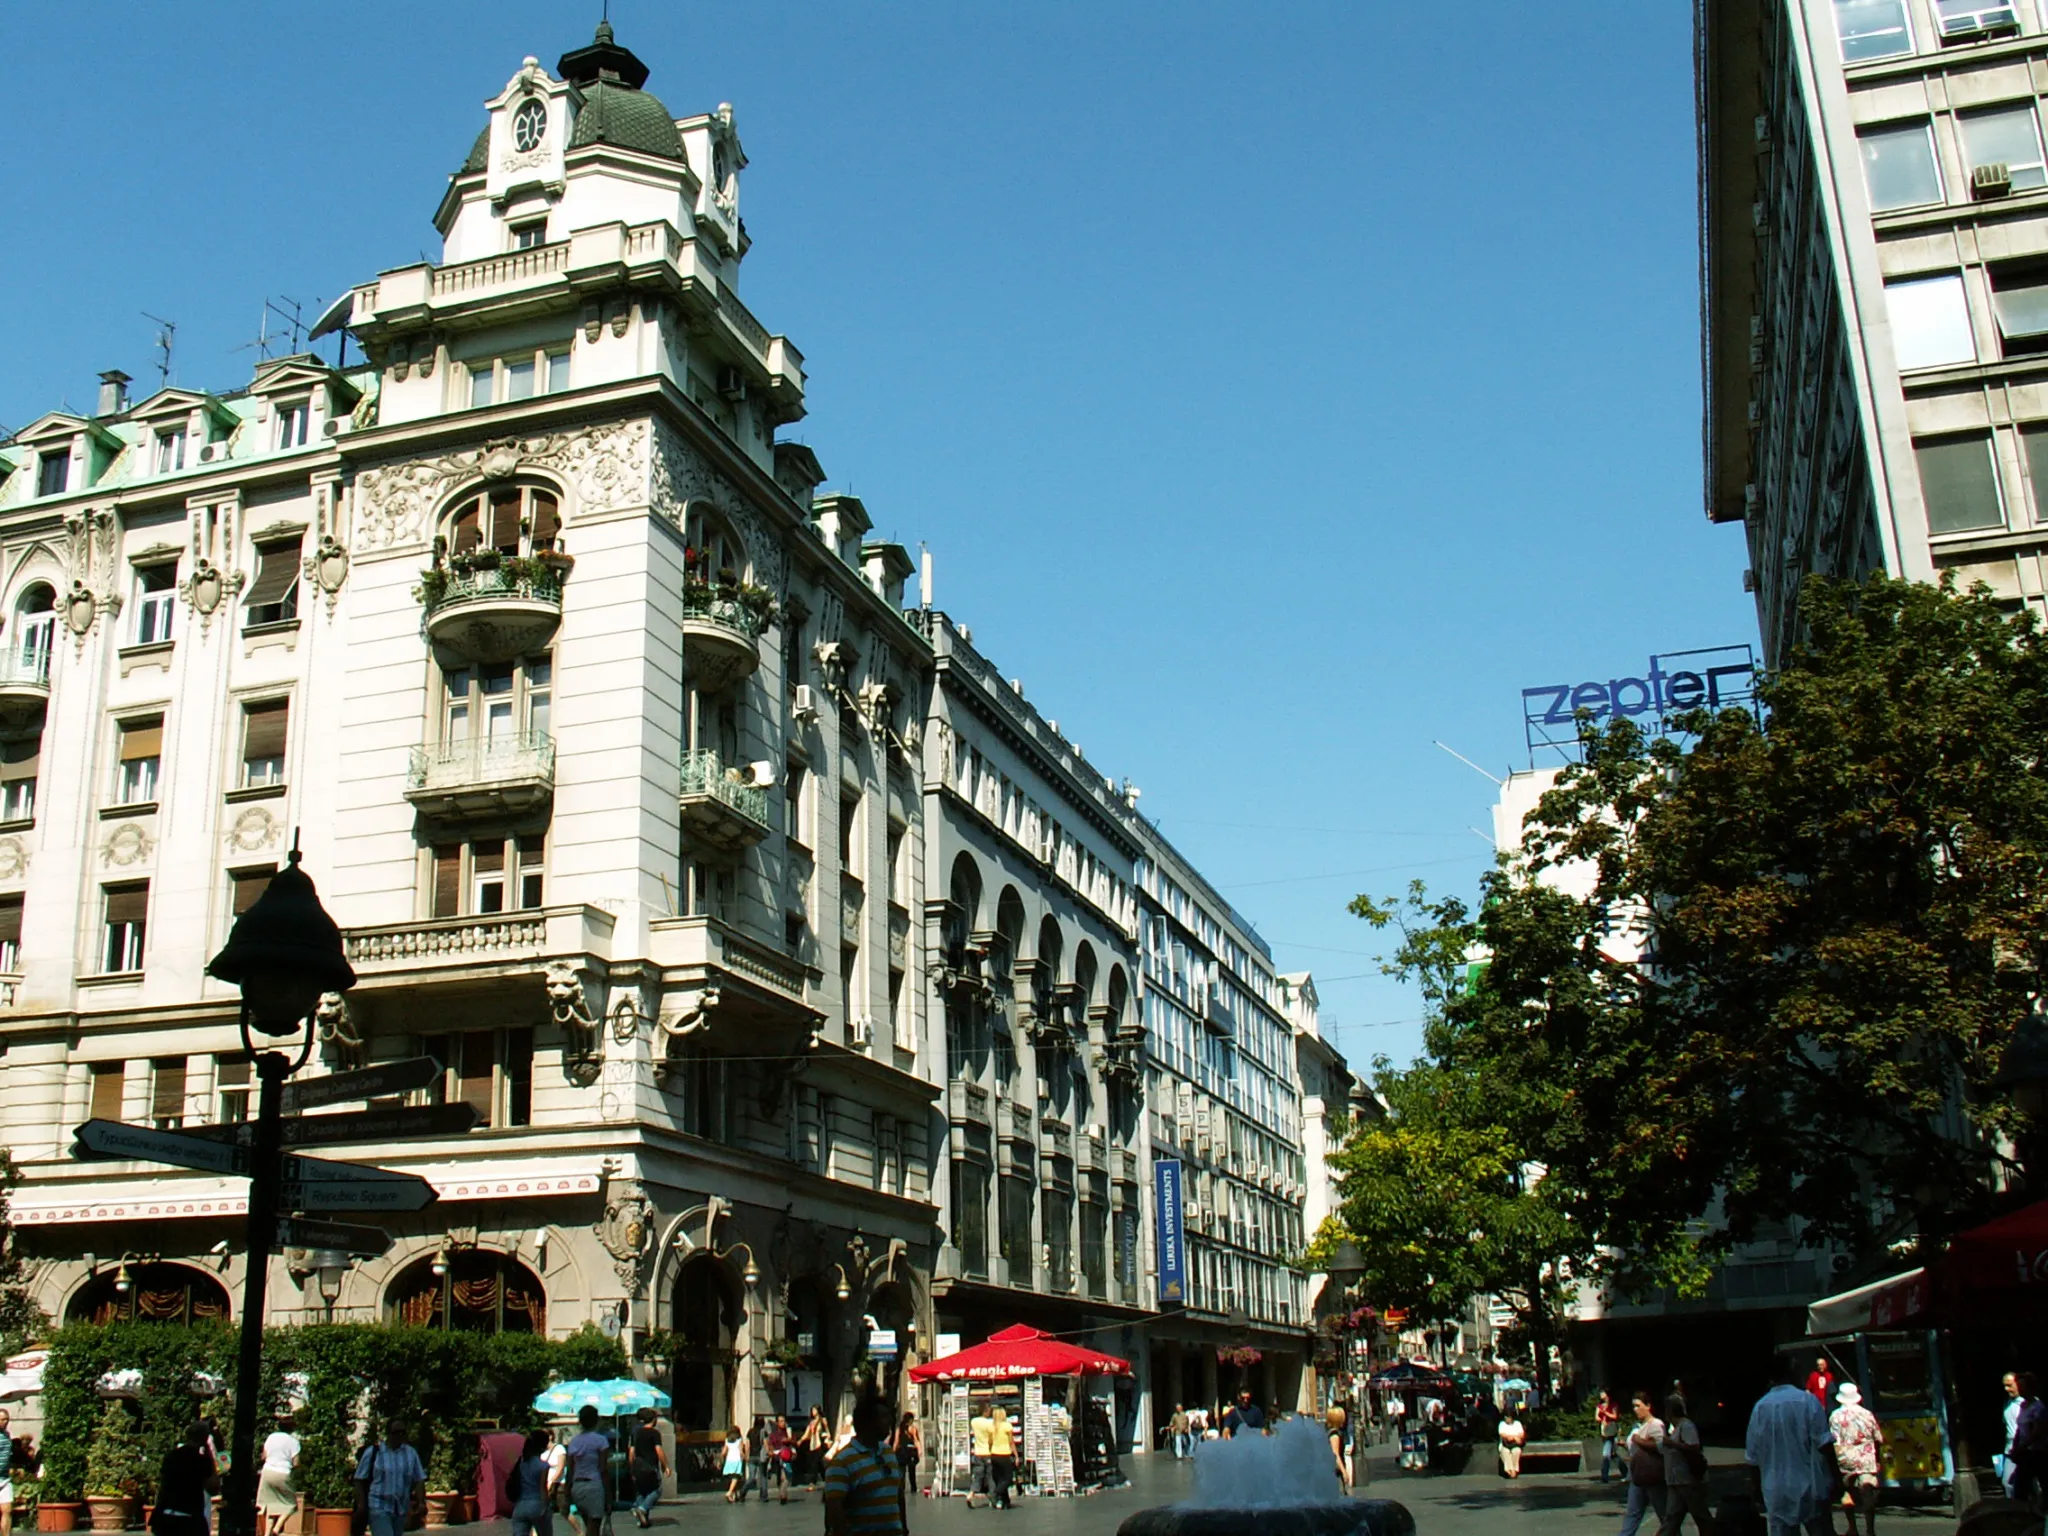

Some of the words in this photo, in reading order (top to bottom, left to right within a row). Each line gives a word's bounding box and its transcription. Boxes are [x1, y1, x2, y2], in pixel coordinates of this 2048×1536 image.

[1522, 655, 1753, 725] zepter
[1162, 1169, 1175, 1234] INVESTMENTS
[968, 1364, 1006, 1378] Magic
